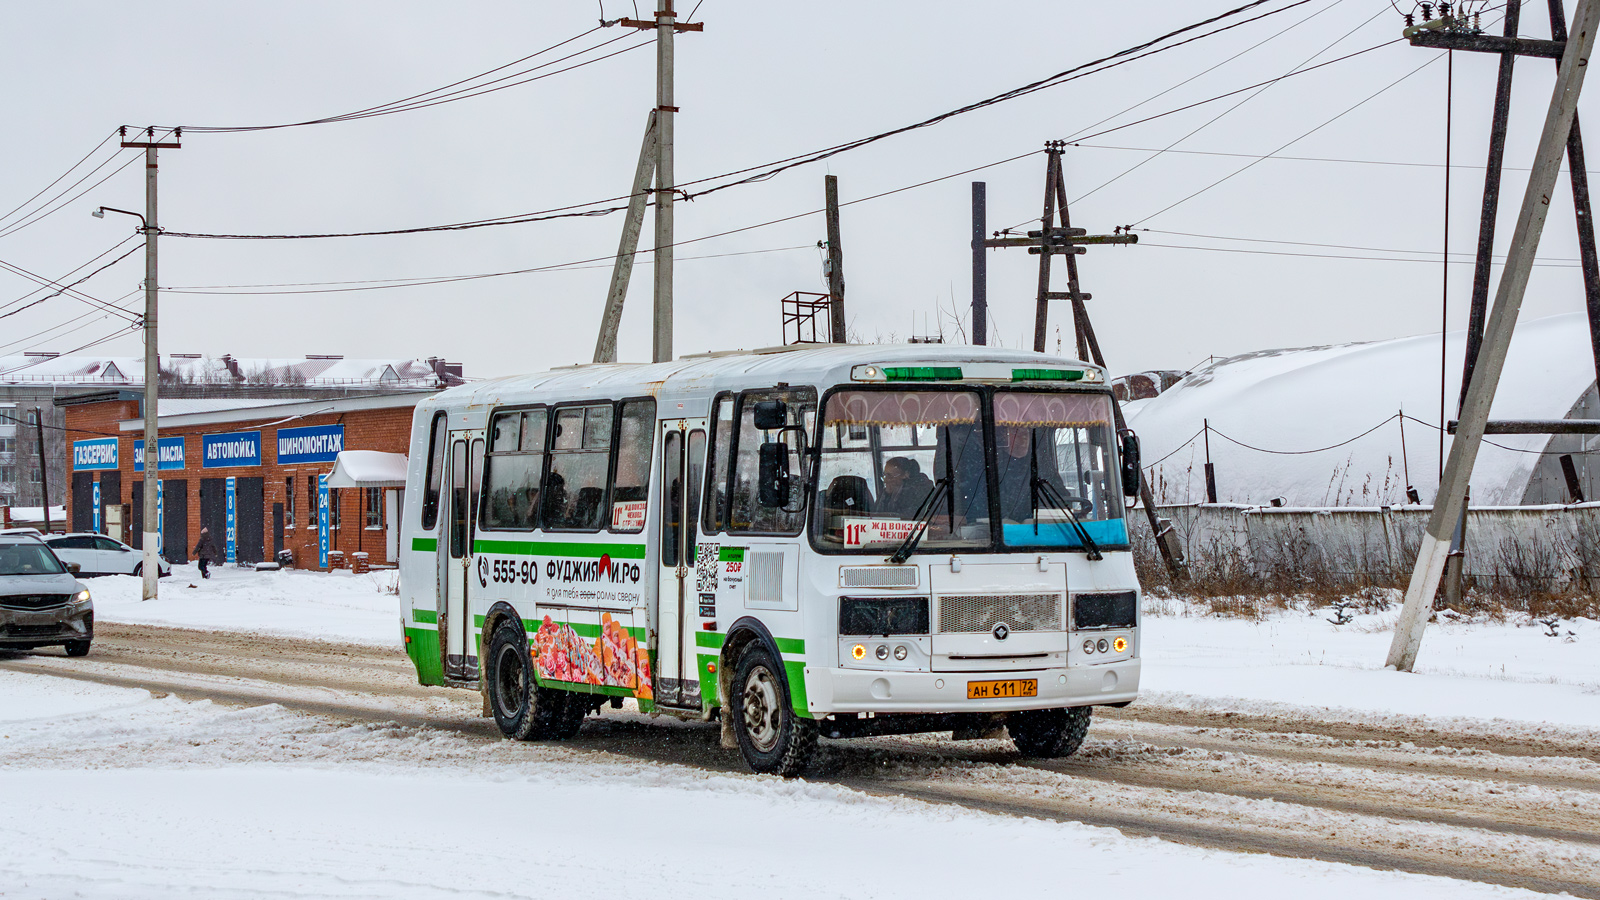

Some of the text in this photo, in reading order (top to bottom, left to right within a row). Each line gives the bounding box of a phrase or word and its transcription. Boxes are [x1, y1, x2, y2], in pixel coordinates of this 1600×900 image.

[207, 437, 256, 460] АВТОМОЙКА
[279, 434, 342, 456] ШИНОМОНТАЖ
[74, 444, 117, 465] ГАЗСЕРВИС
[160, 445, 184, 462] МАСЛА
[228, 495, 233, 510] 8
[319, 493, 328, 509] 24
[227, 527, 235, 542] 23
[493, 559, 538, 585] 555-90
[726, 561, 742, 573] 250₽
[546, 588, 551, 597] я
[551, 588, 562, 600] для
[562, 587, 579, 599] тебя
[596, 590, 616, 603] роллы
[617, 592, 640, 606] сверну
[973, 682, 1015, 697] АН 611
[1022, 681, 1033, 691] 72
